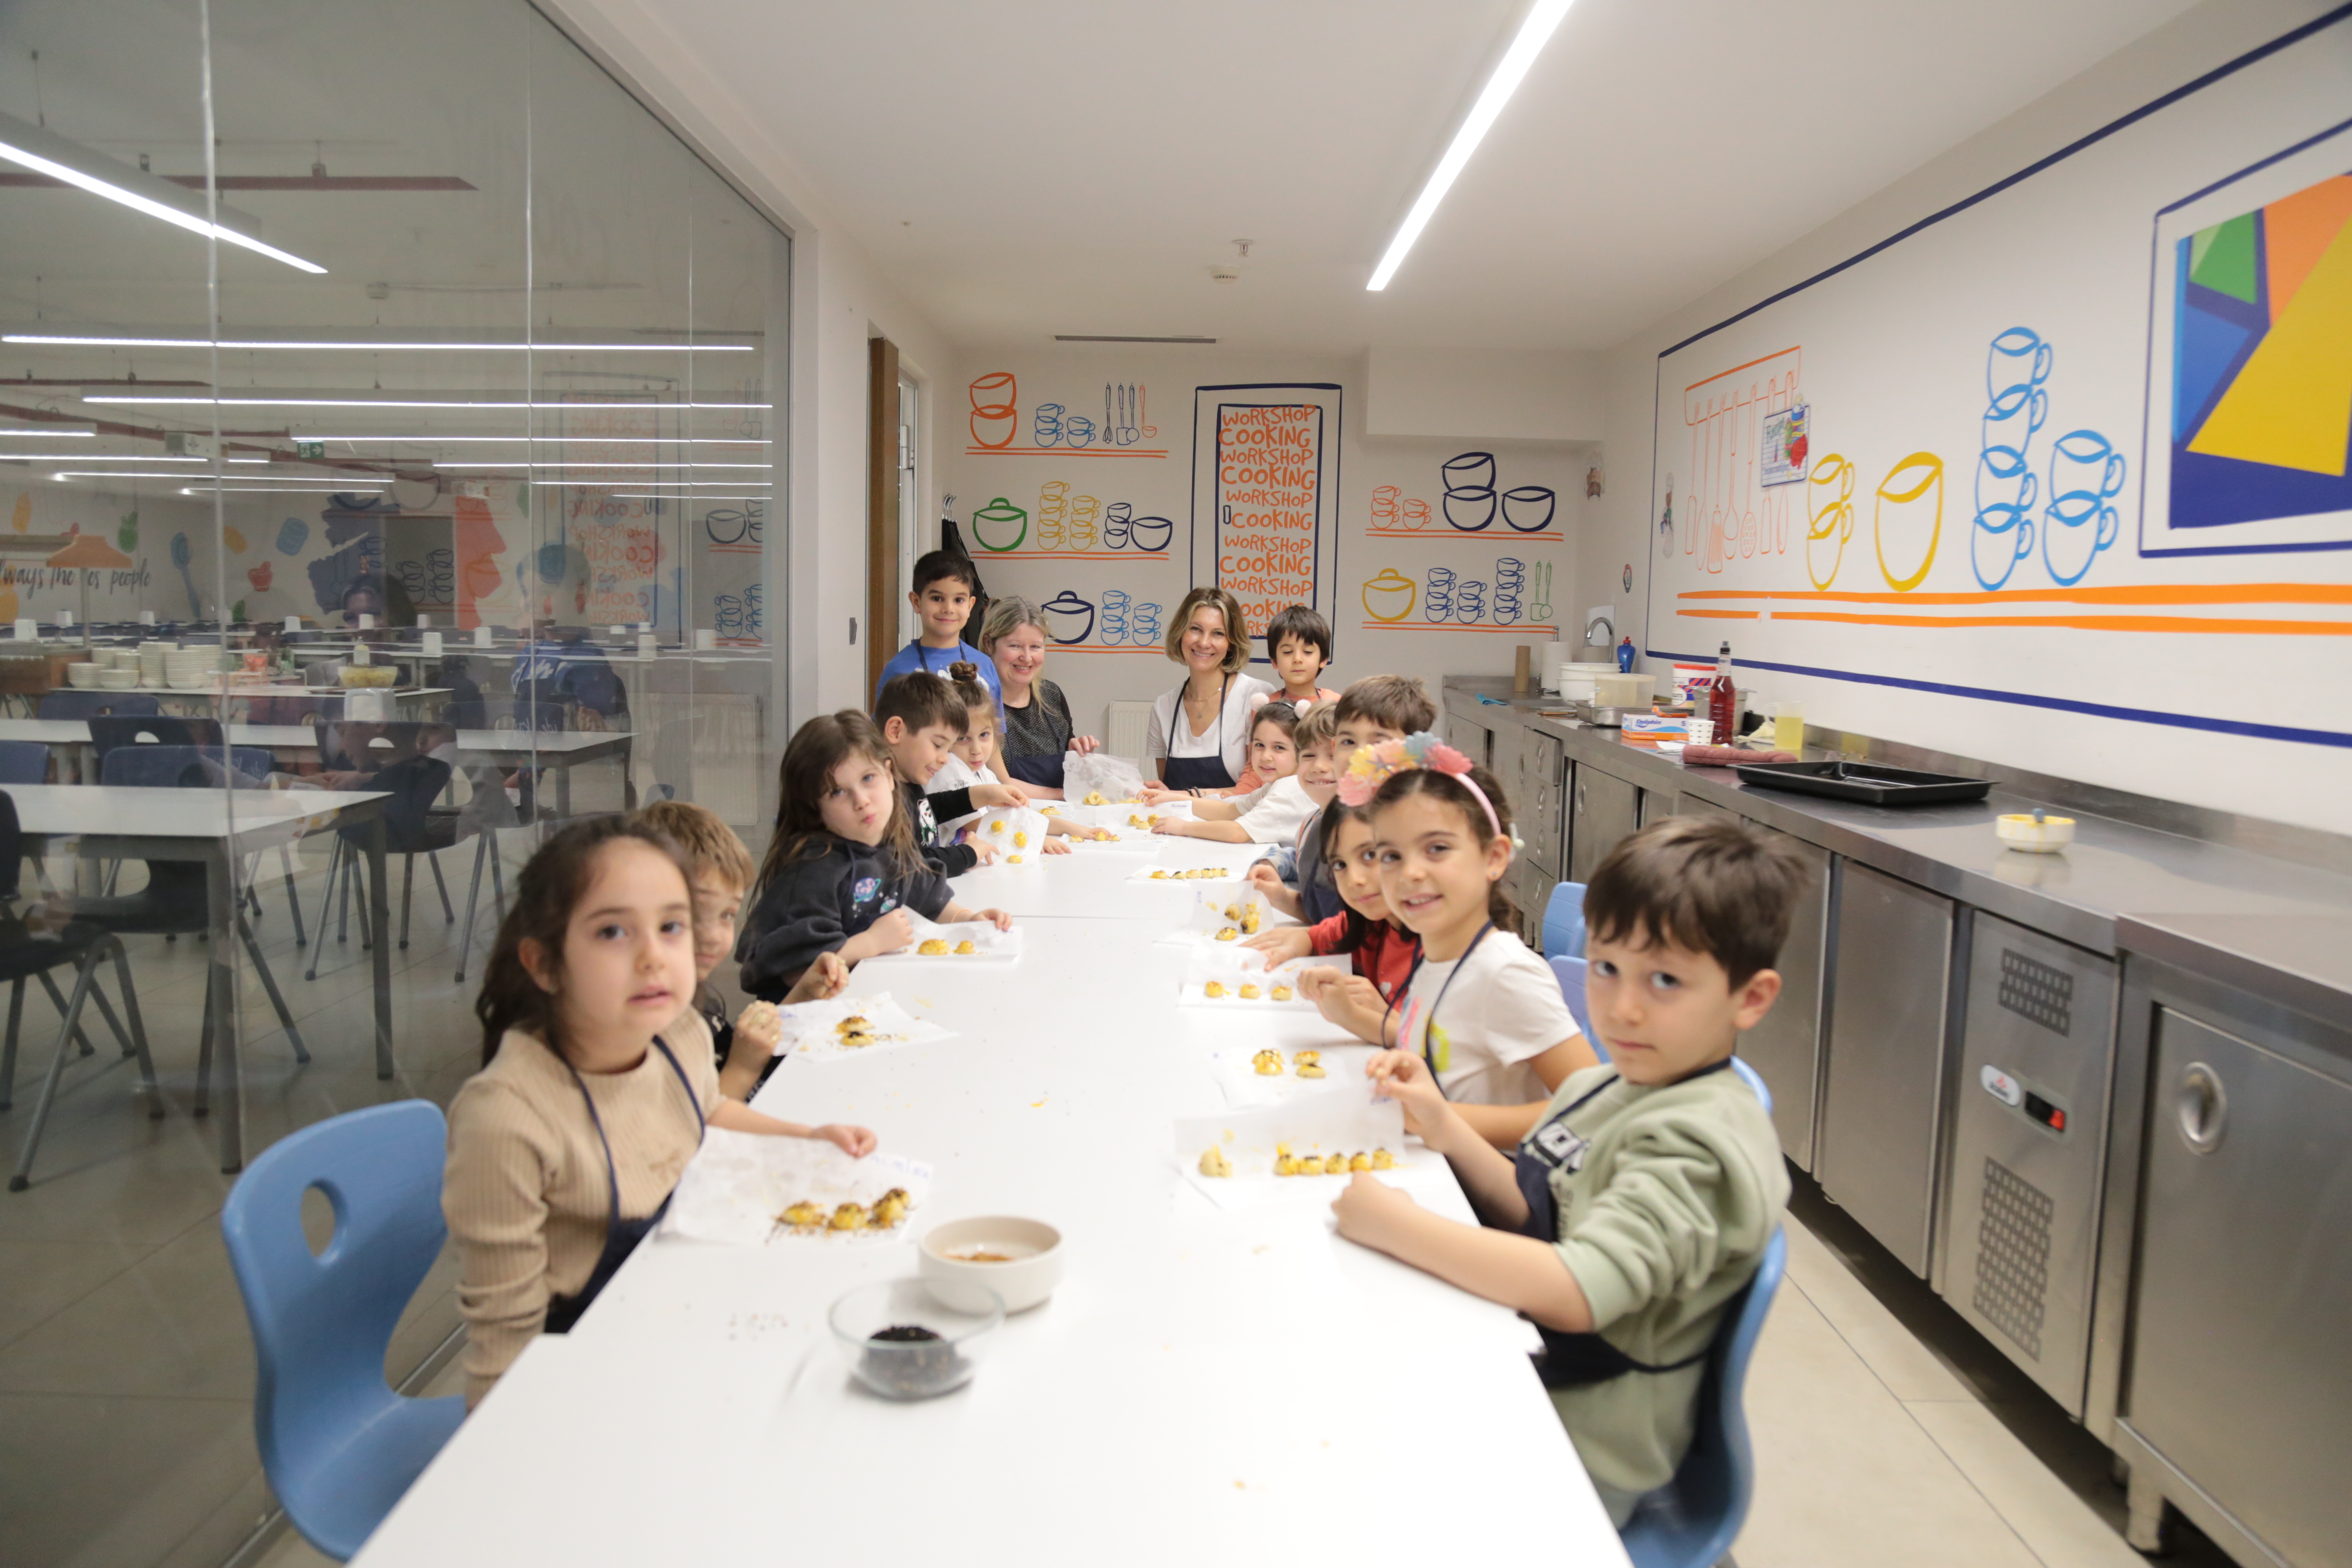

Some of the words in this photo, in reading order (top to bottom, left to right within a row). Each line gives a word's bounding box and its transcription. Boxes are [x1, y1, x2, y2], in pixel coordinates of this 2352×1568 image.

[1223, 404, 1317, 426] WORKSHOP
[1219, 423, 1311, 449] COOKING
[1220, 447, 1314, 466] WORKSHOP
[1221, 464, 1316, 490] COOKING
[1226, 489, 1314, 508] WORKSHOP
[1231, 508, 1312, 531] COOKING
[1225, 534, 1312, 554] WORKSHOP
[1219, 551, 1311, 576] COOKING
[110, 558, 150, 595] people
[1221, 576, 1314, 597] WORKSHOP
[1240, 598, 1305, 621] OOKI
